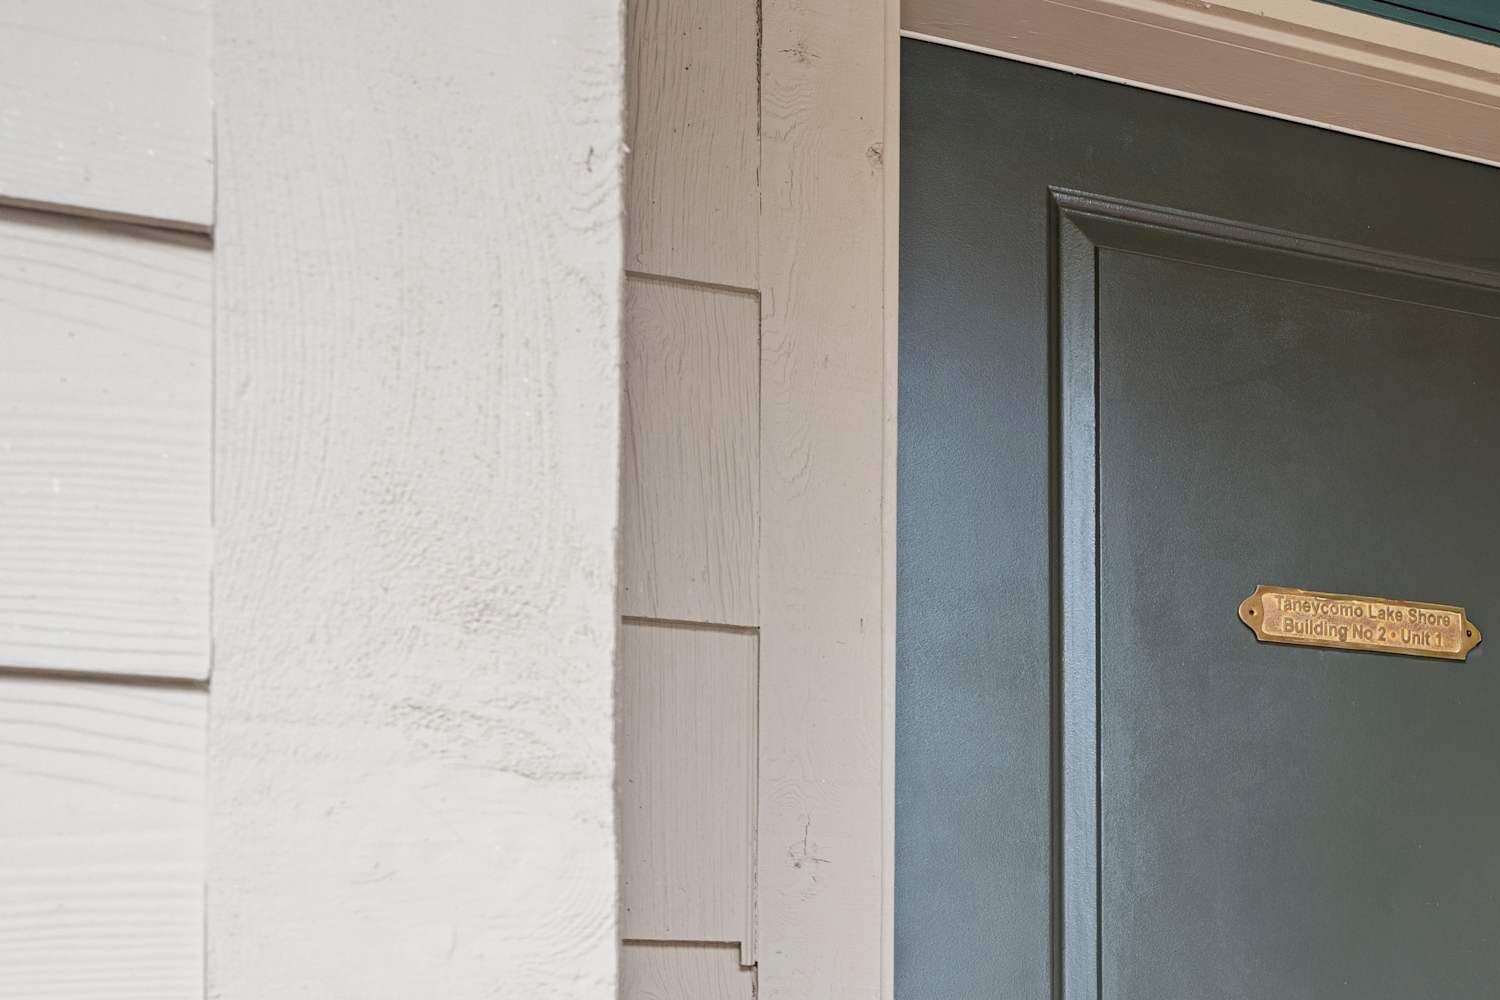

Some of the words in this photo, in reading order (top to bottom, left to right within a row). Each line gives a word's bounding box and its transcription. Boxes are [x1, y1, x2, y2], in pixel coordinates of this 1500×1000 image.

[1277, 595, 1363, 618] Taneycomo
[1368, 605, 1403, 622] Lake
[1408, 608, 1451, 627] Shore
[1284, 619, 1348, 642] Building
[1352, 624, 1373, 641] No
[1377, 626, 1387, 642] 2
[1401, 629, 1431, 645] Unit
[1435, 633, 1443, 646] 1
